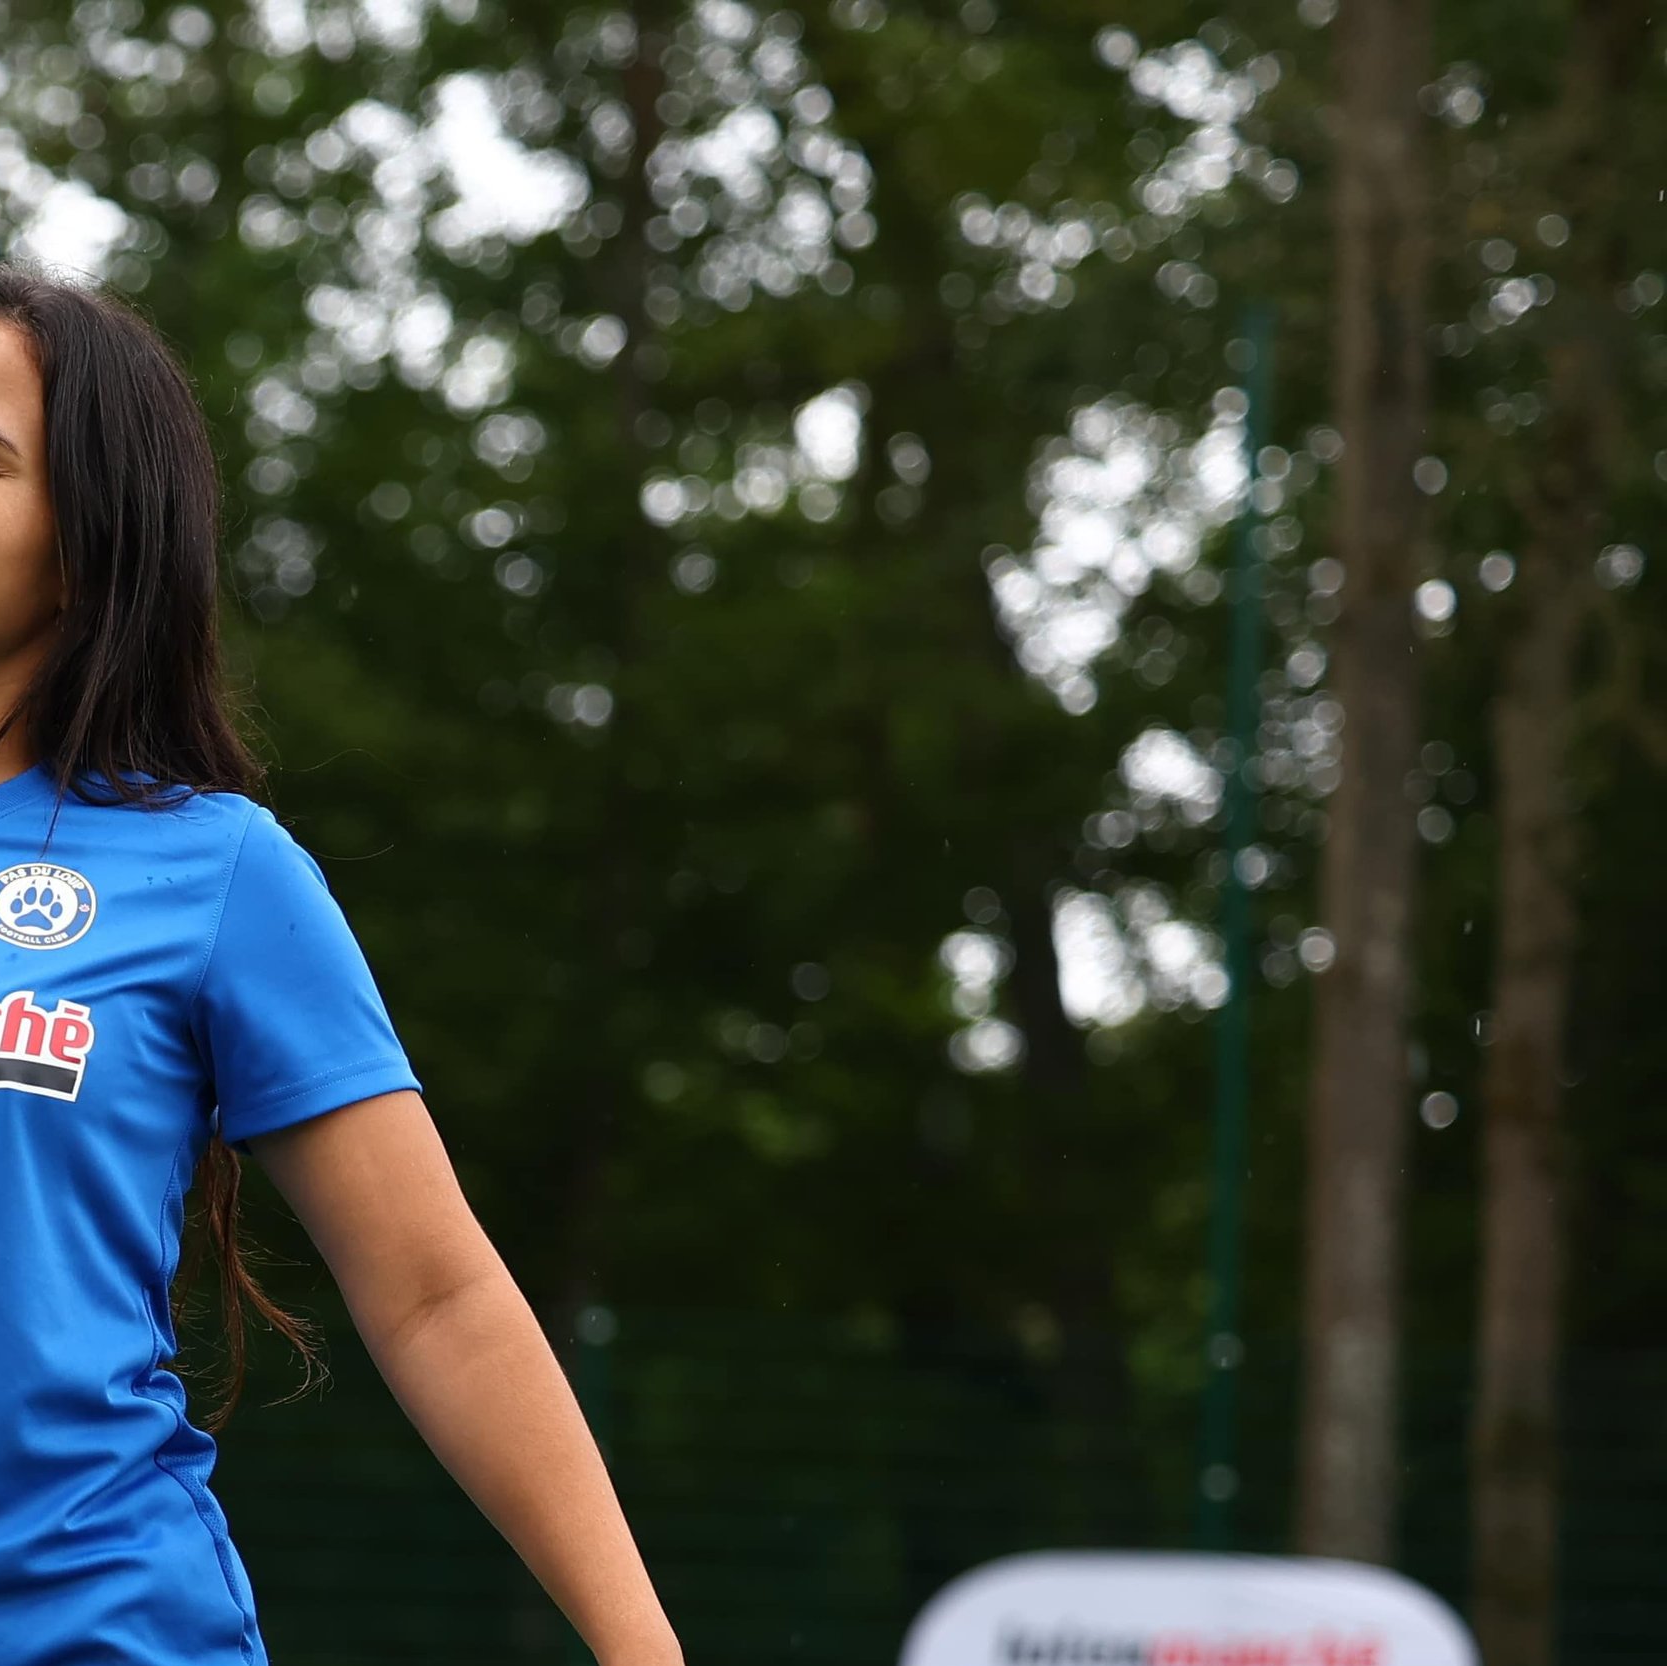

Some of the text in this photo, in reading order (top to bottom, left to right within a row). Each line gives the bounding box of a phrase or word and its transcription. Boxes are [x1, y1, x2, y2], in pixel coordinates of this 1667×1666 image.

[30, 866, 52, 876] DU
[53, 870, 86, 890] LOUP
[43, 931, 69, 944] CLUB
